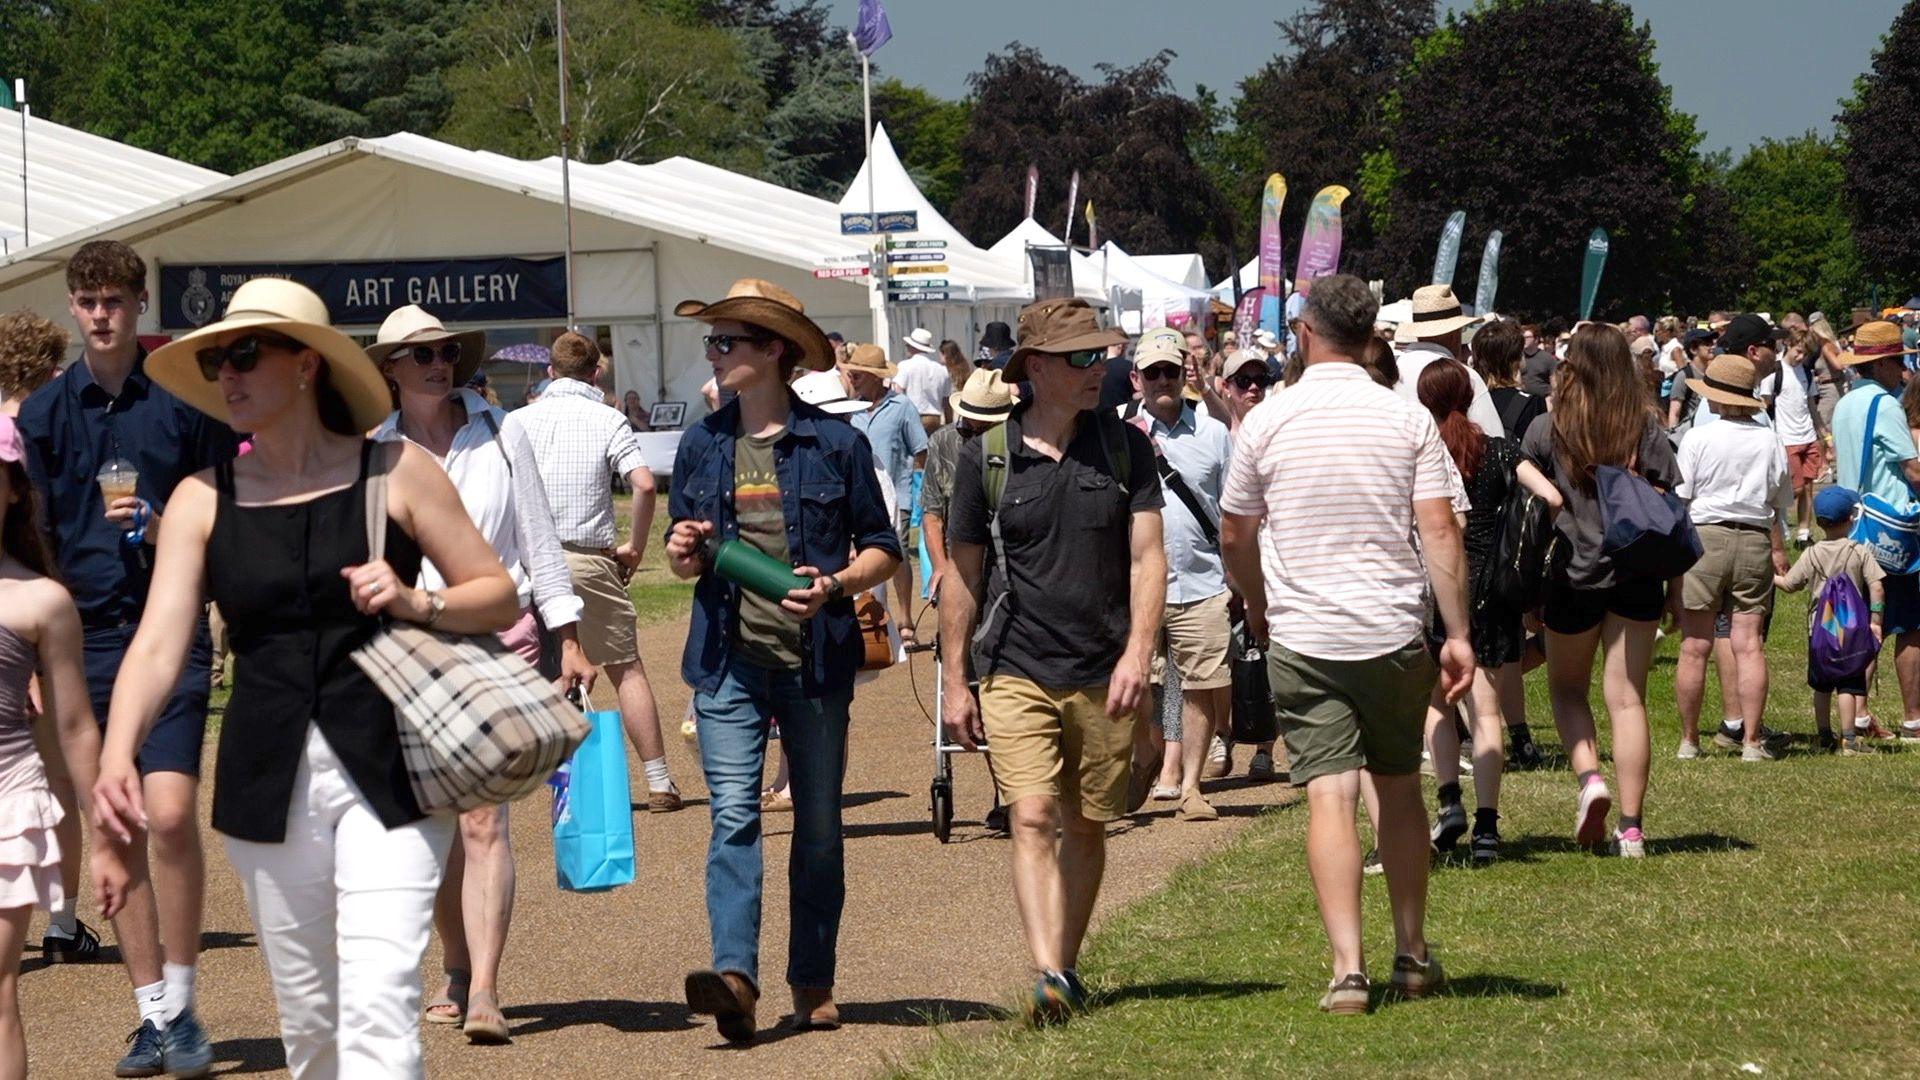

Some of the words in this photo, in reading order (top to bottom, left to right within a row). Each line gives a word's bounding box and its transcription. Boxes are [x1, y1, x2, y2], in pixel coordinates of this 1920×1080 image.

[817, 269, 830, 278] RED
[832, 269, 844, 278] CAR
[846, 268, 862, 277] PARK
[346, 278, 394, 307] ART
[407, 273, 519, 304] GALLERY
[899, 293, 925, 301] SPORTS
[926, 292, 944, 300] ZONE
